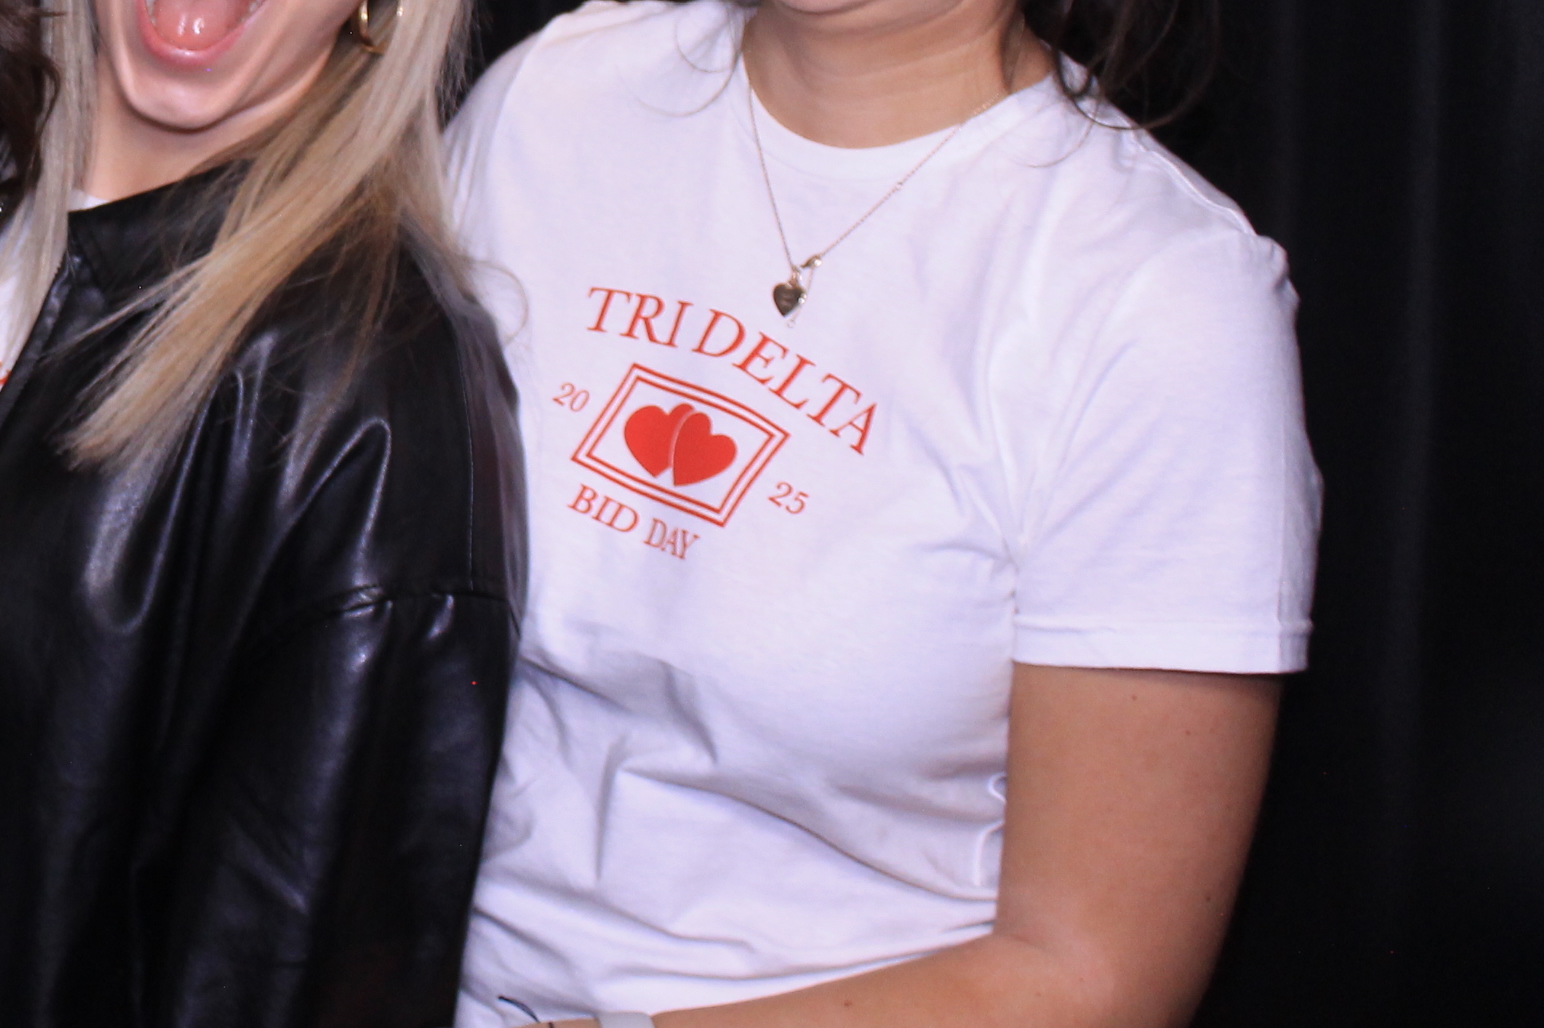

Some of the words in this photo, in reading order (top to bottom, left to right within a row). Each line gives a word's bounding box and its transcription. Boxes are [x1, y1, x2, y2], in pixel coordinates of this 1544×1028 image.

[553, 383, 590, 412] 20
[587, 287, 693, 347] TRI
[692, 309, 877, 454] DELTA
[568, 484, 640, 533] BID
[644, 518, 700, 559] DAY
[769, 482, 809, 515] 25
